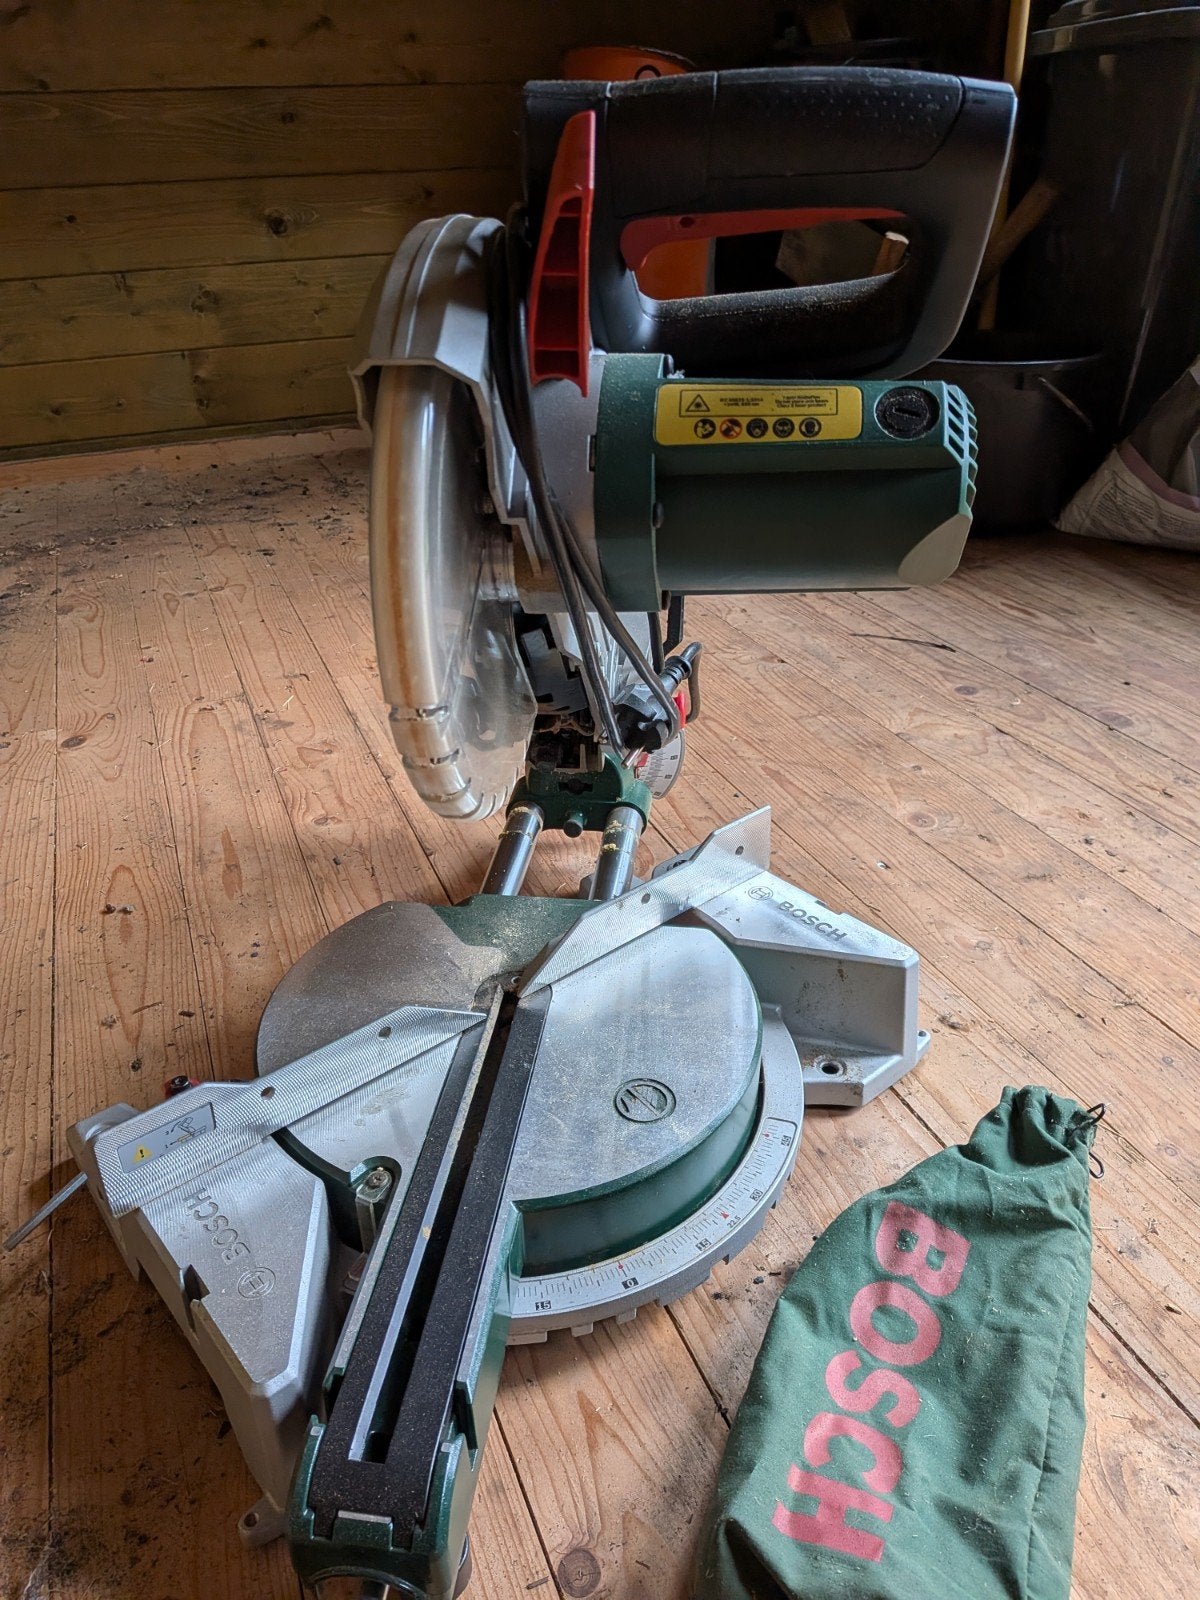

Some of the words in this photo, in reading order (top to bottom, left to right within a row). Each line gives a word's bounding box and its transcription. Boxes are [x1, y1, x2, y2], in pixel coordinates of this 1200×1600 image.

[779, 901, 848, 941] BOSCH
[183, 1188, 250, 1265] BOSCH
[726, 1215, 742, 1229] 22.5
[535, 1300, 551, 1311] 15
[772, 1201, 971, 1562] BOSCH
